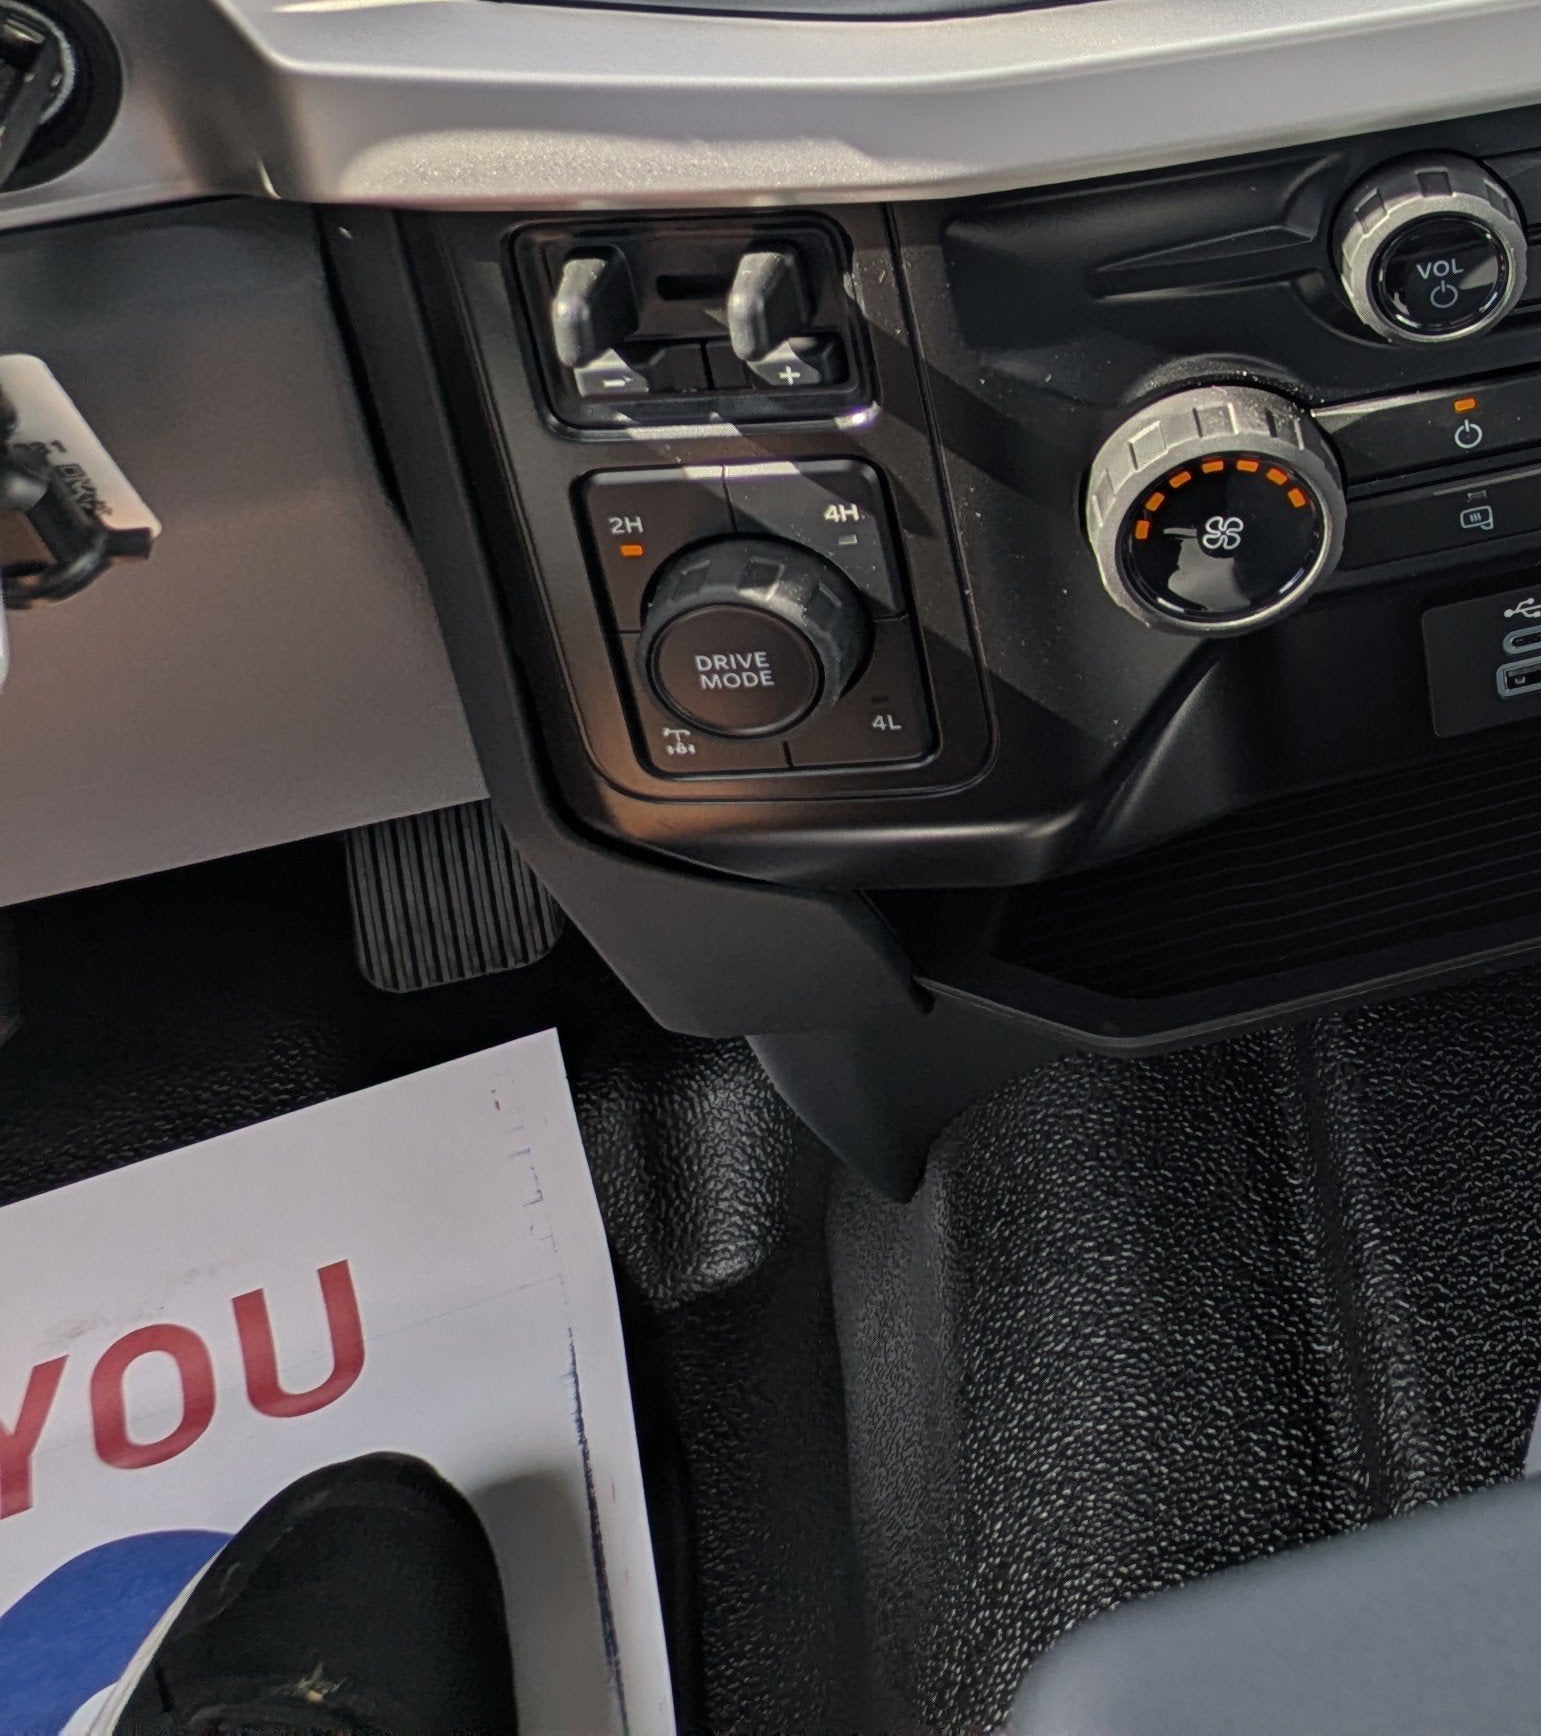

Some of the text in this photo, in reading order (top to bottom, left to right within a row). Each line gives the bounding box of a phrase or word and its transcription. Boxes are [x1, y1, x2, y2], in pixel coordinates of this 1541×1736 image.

[1416, 256, 1464, 282] VOL
[823, 502, 859, 523] 4H
[609, 515, 644, 535] 2H
[695, 650, 771, 673] DRIVE
[700, 668, 775, 691] MODE
[871, 713, 902, 732] 4L
